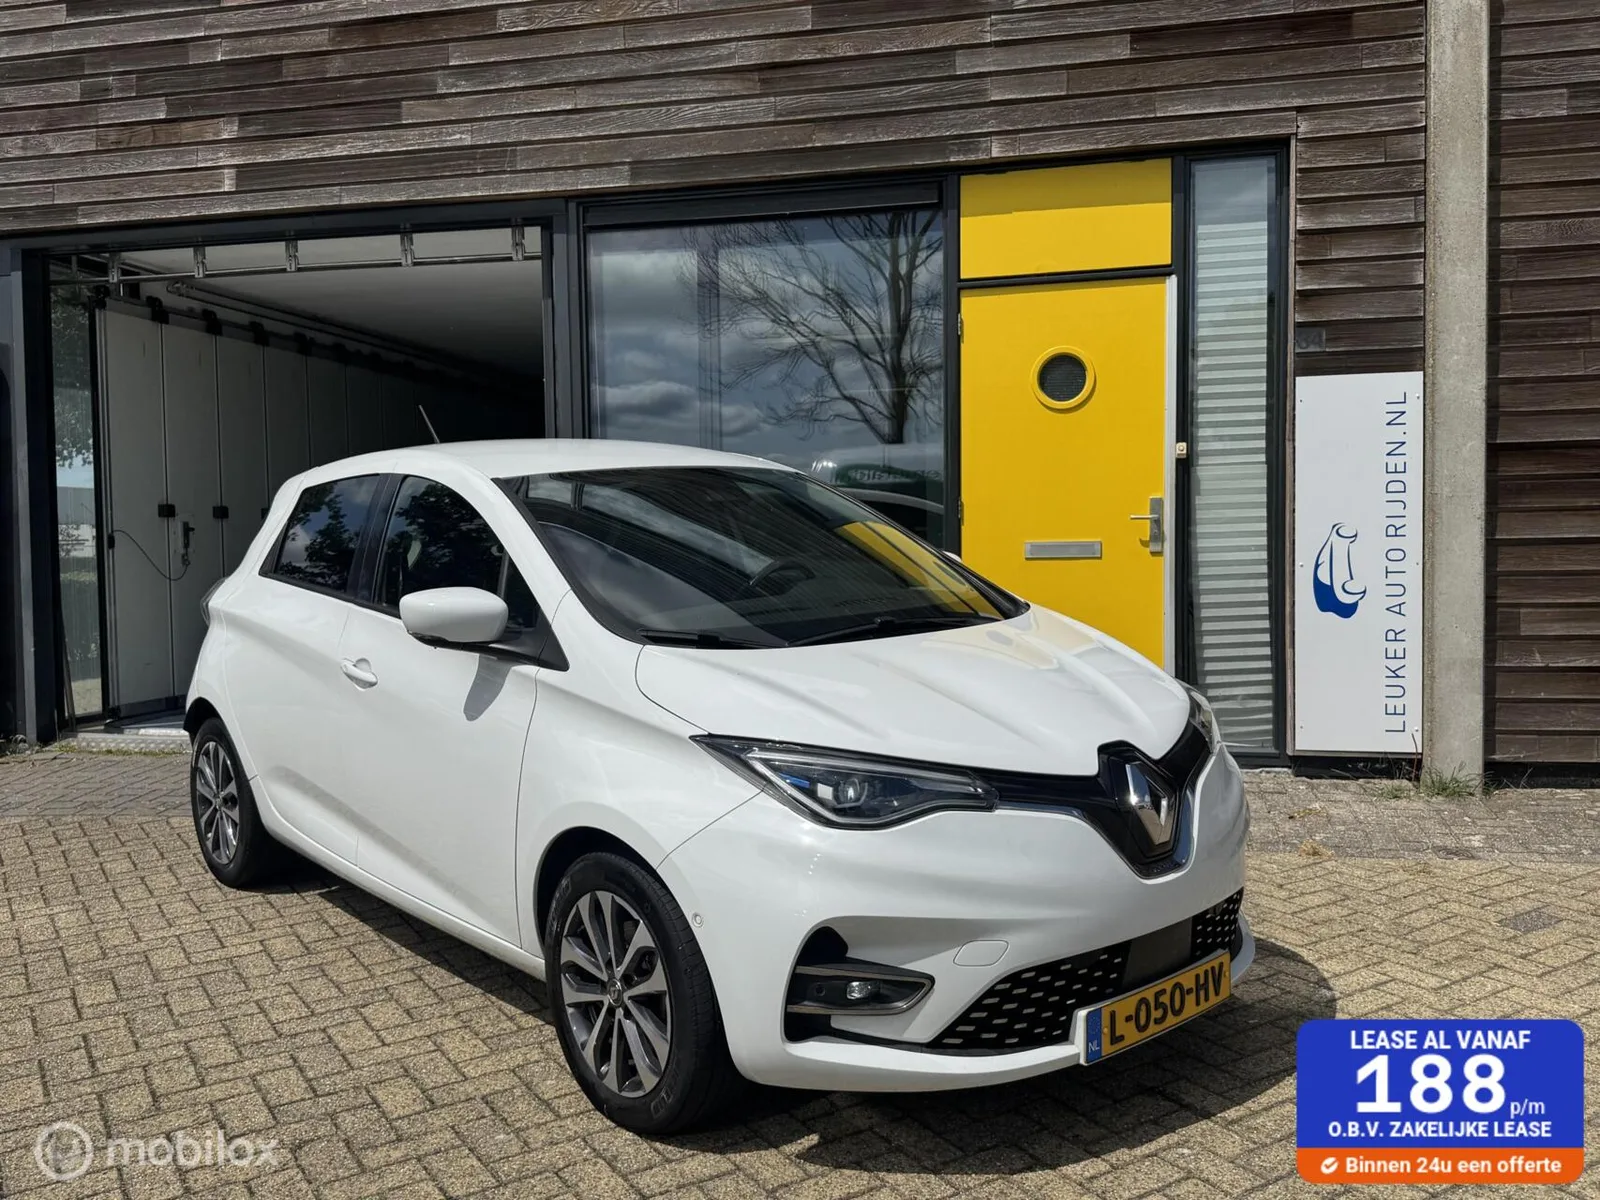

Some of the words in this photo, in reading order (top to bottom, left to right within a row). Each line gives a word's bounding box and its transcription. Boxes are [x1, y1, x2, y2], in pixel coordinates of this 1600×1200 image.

[1385, 628, 1406, 733] LEUKER
[1088, 1039, 1100, 1053] NL
[1109, 961, 1224, 1046] L-050-HV
